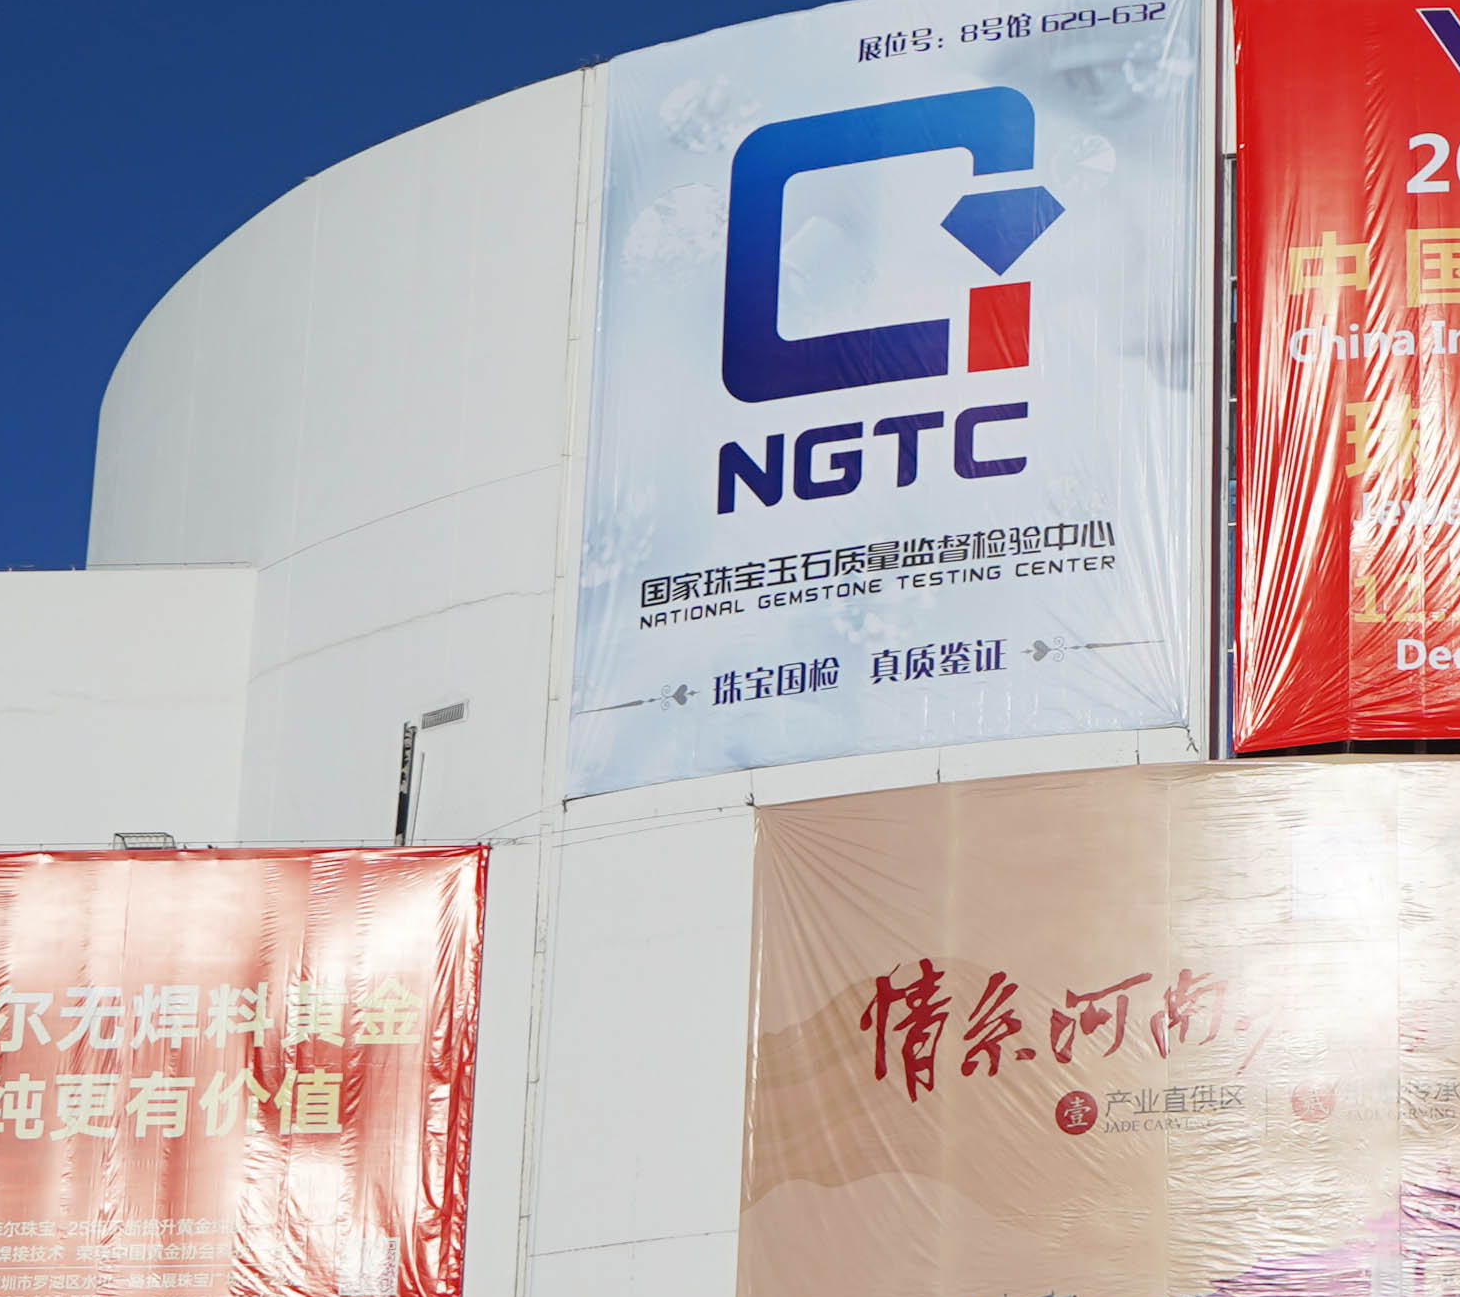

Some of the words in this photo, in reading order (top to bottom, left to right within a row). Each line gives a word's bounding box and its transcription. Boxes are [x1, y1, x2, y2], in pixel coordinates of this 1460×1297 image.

[1042, 1, 1166, 33] 629-632
[1288, 322, 1416, 364] China
[717, 401, 1029, 514] NGTC
[641, 519, 1117, 609] 国家珠宝玉石质量监督检验中心
[639, 600, 745, 630] NATIONAL
[757, 580, 882, 612] GEMSTONE
[896, 565, 1001, 594] TESTING
[1015, 554, 1116, 580] CENTER
[712, 656, 842, 707] 珠宝国检
[870, 638, 1008, 684] 真质鉴证
[1104, 1120, 1140, 1135] JADE
[1105, 1084, 1245, 1117] 产业直供区
